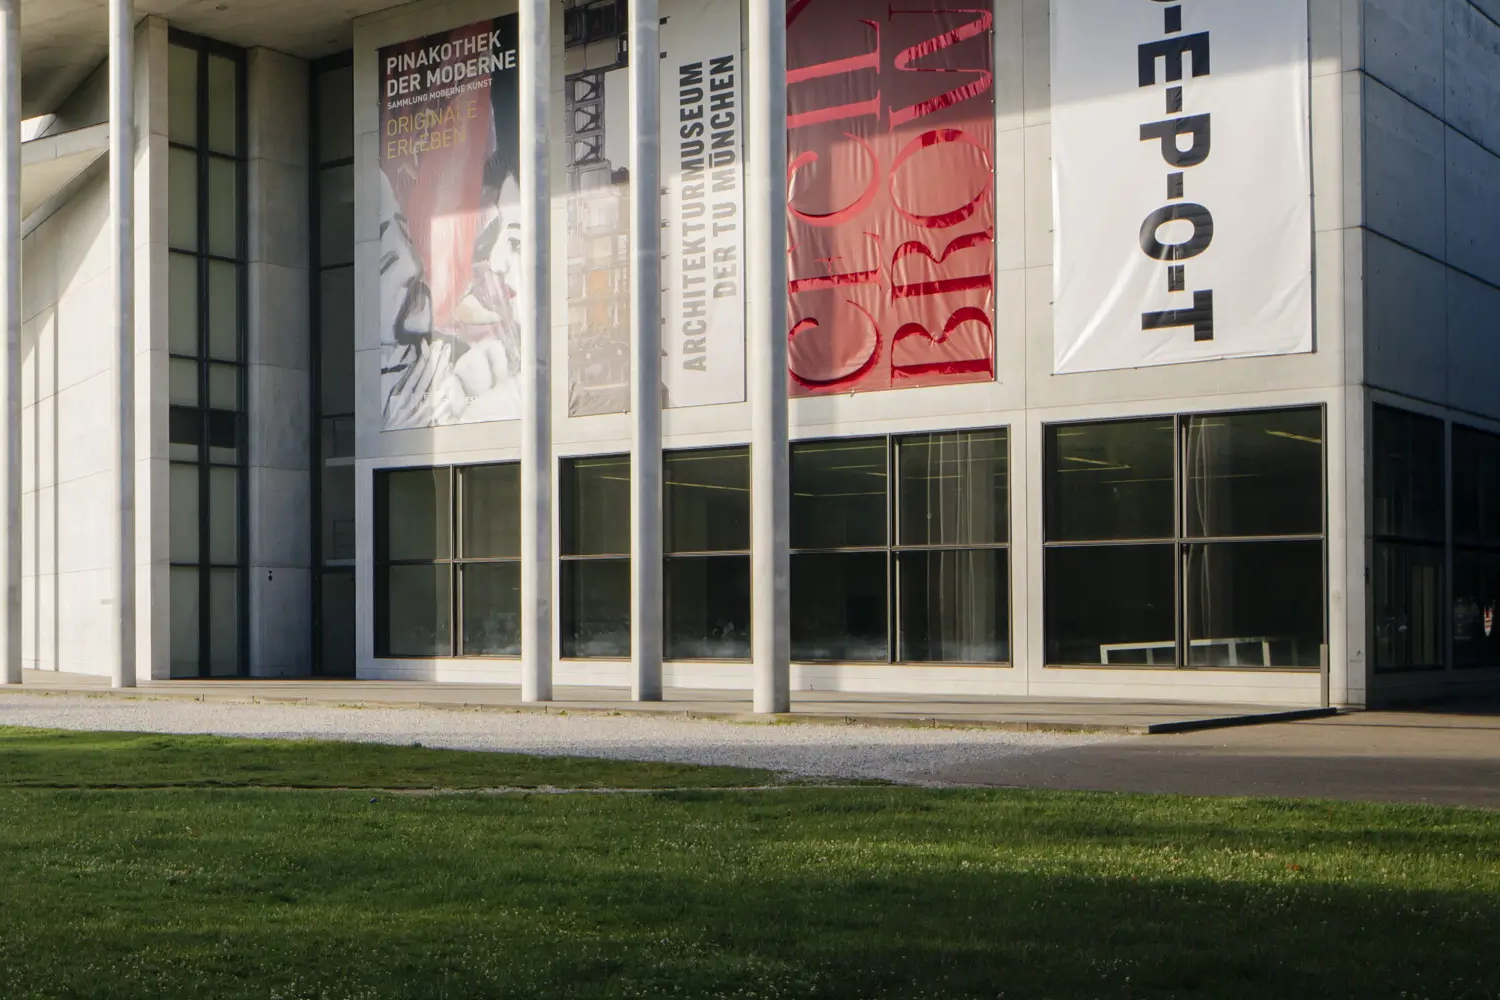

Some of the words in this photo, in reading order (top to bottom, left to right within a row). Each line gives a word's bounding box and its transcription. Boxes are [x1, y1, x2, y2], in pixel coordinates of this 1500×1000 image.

[387, 29, 501, 75] PINAKOTHEK
[387, 73, 421, 98] DER
[426, 49, 517, 88] MODERNE
[387, 93, 428, 110] SAMMLUNG
[429, 84, 466, 100] MODERNE
[467, 78, 493, 92] KUNST
[387, 100, 478, 137] ORIGINALE
[387, 127, 467, 159] ERLEBEN
[679, 61, 707, 373] ARCHITEKTURMUSEUM
[712, 200, 737, 238] TU
[712, 244, 738, 299] DER
